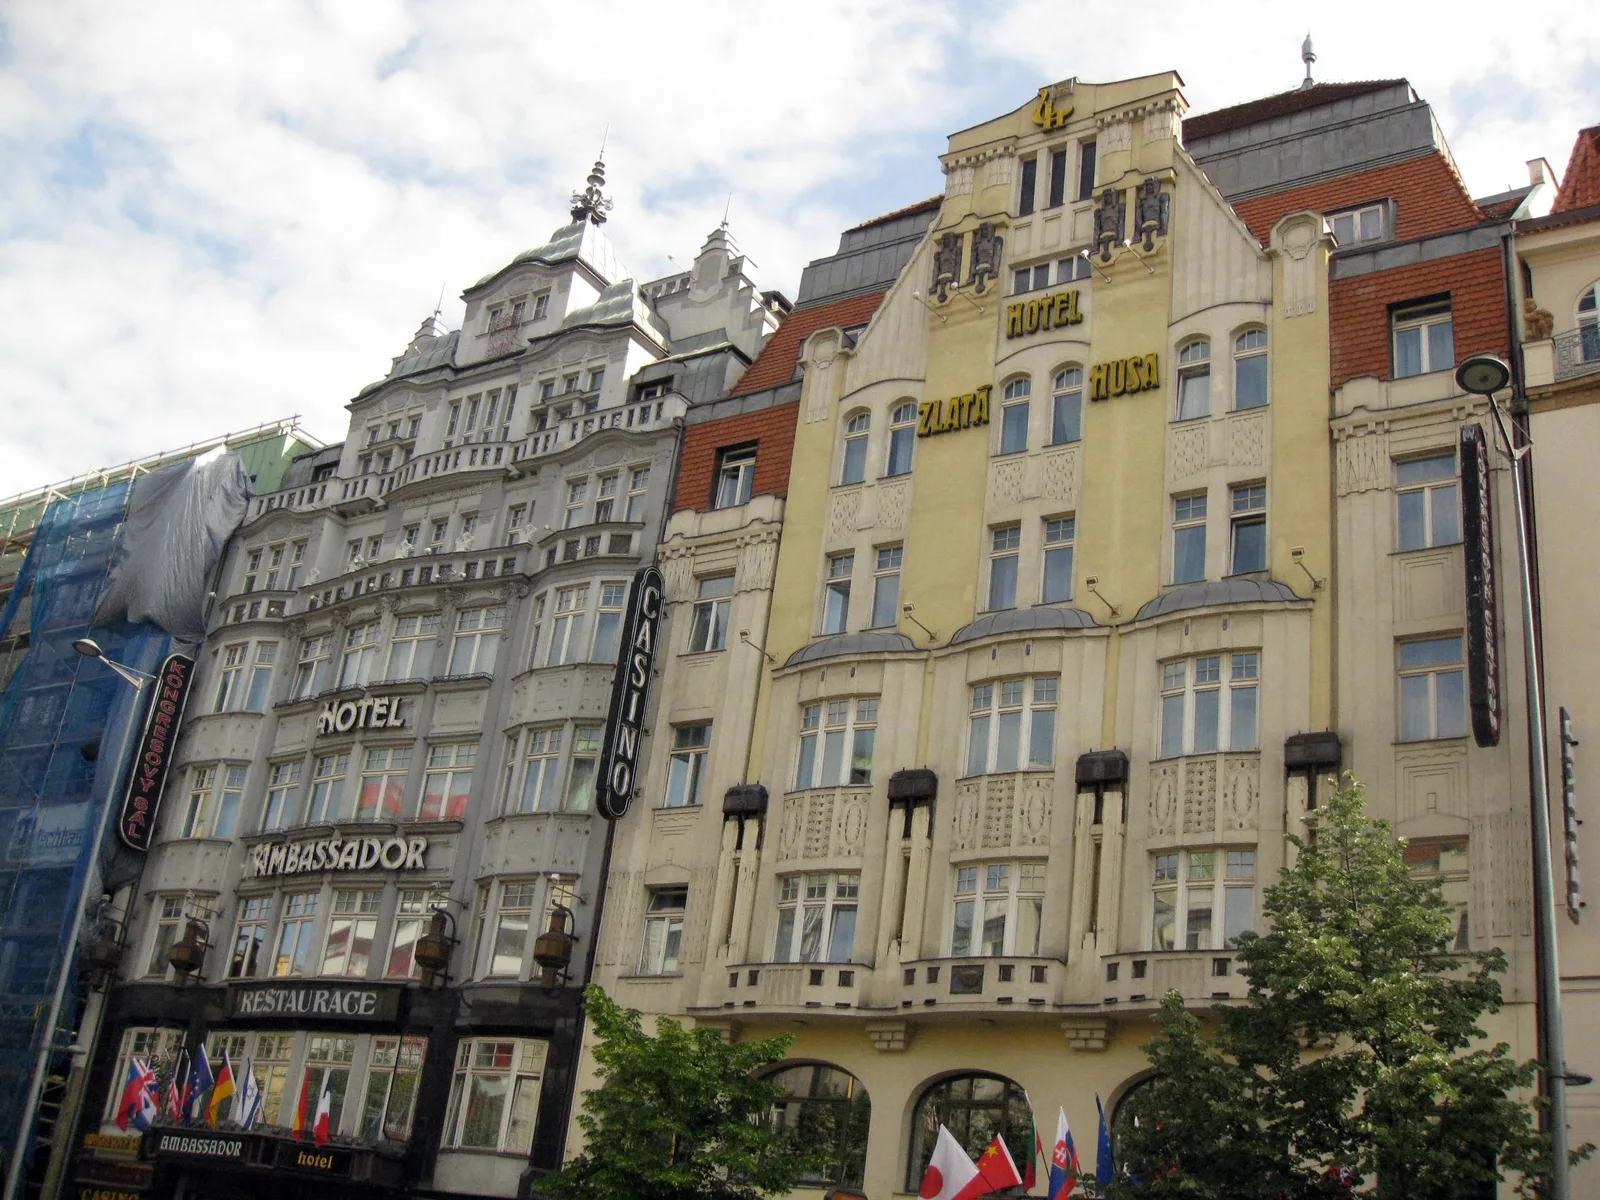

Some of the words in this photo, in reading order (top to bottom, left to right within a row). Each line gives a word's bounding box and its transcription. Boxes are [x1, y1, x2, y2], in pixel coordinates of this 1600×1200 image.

[1007, 288, 1083, 339] HOTEL
[1090, 352, 1160, 402] HUSA
[613, 586, 660, 797] CASINO
[316, 696, 405, 735] HOTEL
[253, 836, 428, 878] AMBASSADOR
[240, 987, 377, 1016] RESTAURACE
[160, 1135, 243, 1157] AMBASSADOR
[297, 1151, 334, 1169] hotel
